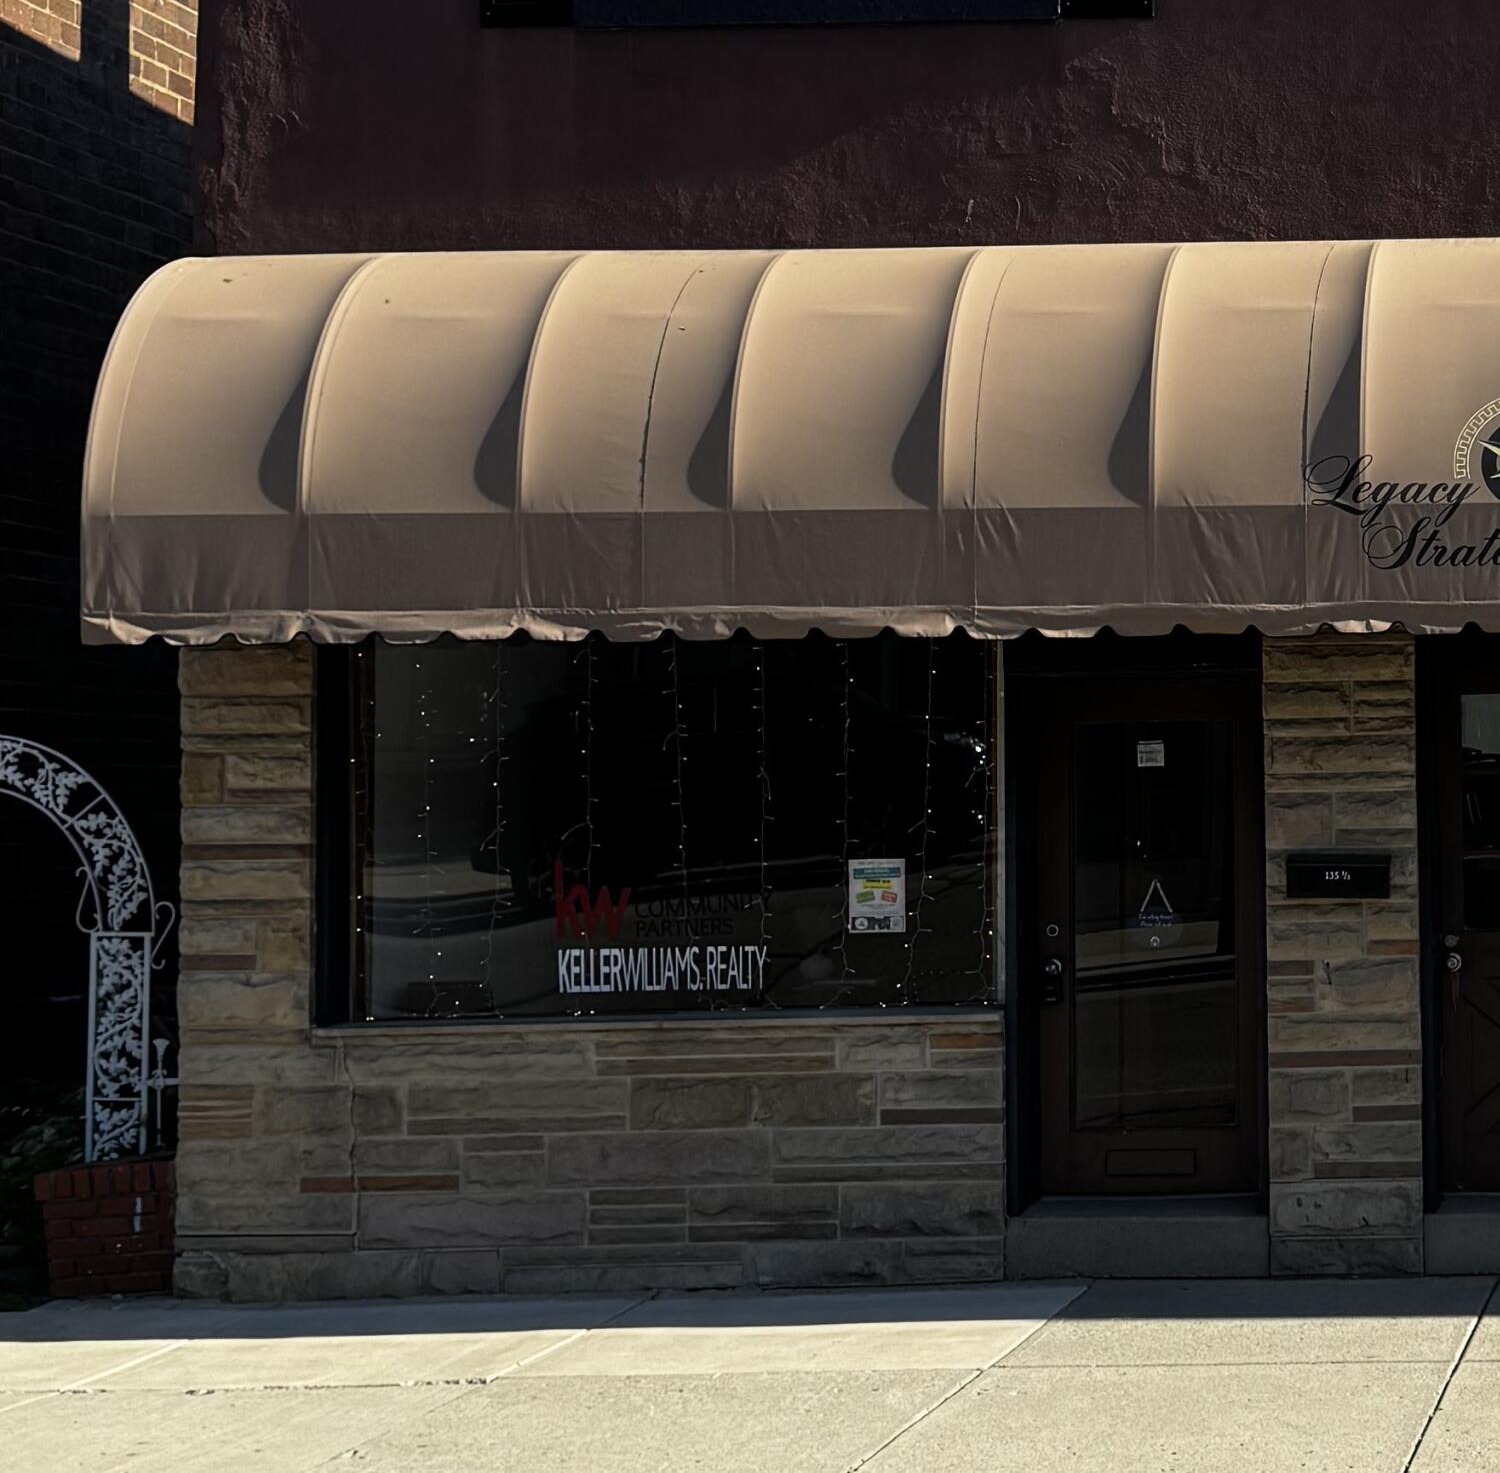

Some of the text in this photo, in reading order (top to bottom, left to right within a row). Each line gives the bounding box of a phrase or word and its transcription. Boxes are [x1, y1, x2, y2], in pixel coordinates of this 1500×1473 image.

[1303, 454, 1480, 528] Legacy
[636, 917, 734, 939] PARTNERS
[706, 945, 767, 991] REALTY
